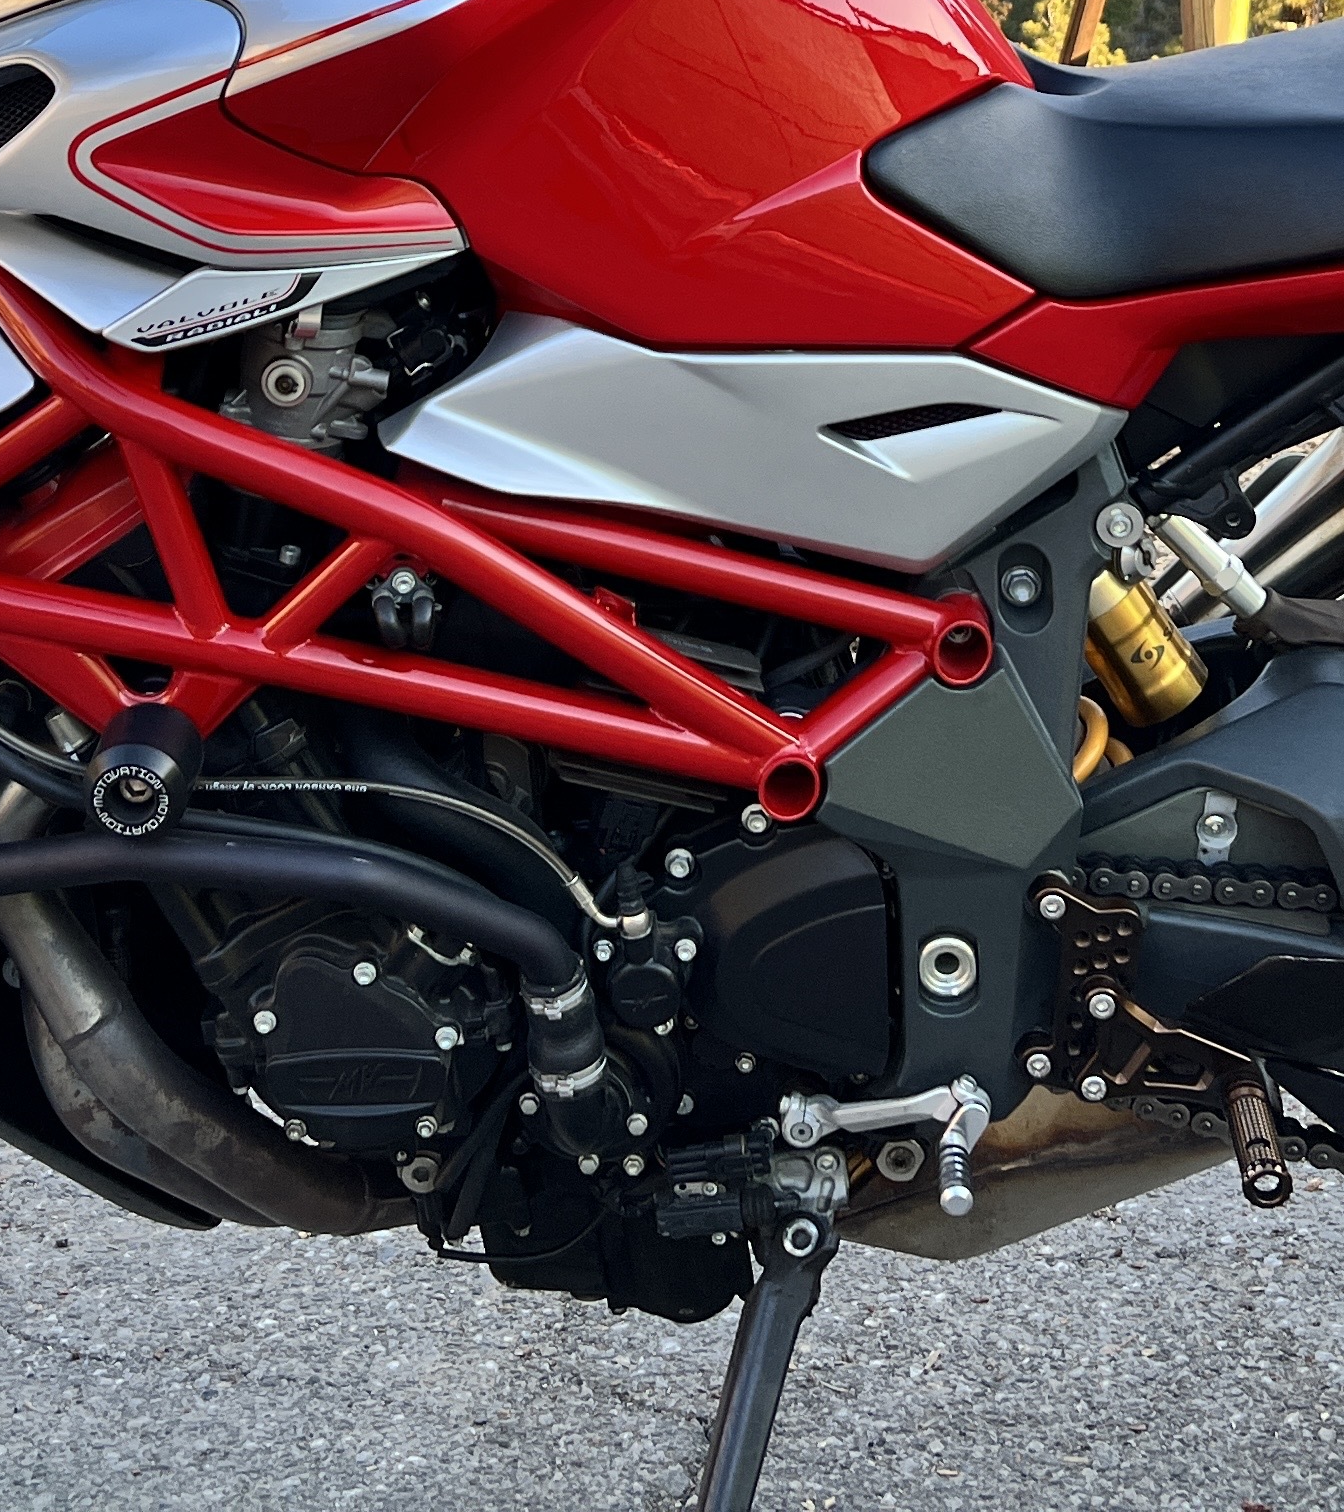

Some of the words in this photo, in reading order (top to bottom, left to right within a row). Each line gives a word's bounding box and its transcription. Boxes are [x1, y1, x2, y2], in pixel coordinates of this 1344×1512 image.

[137, 288, 280, 333] VALVOLE
[165, 303, 278, 342] RADIALI
[93, 766, 164, 808] MOTOVATION
[98, 794, 169, 836] MOTOVATION
